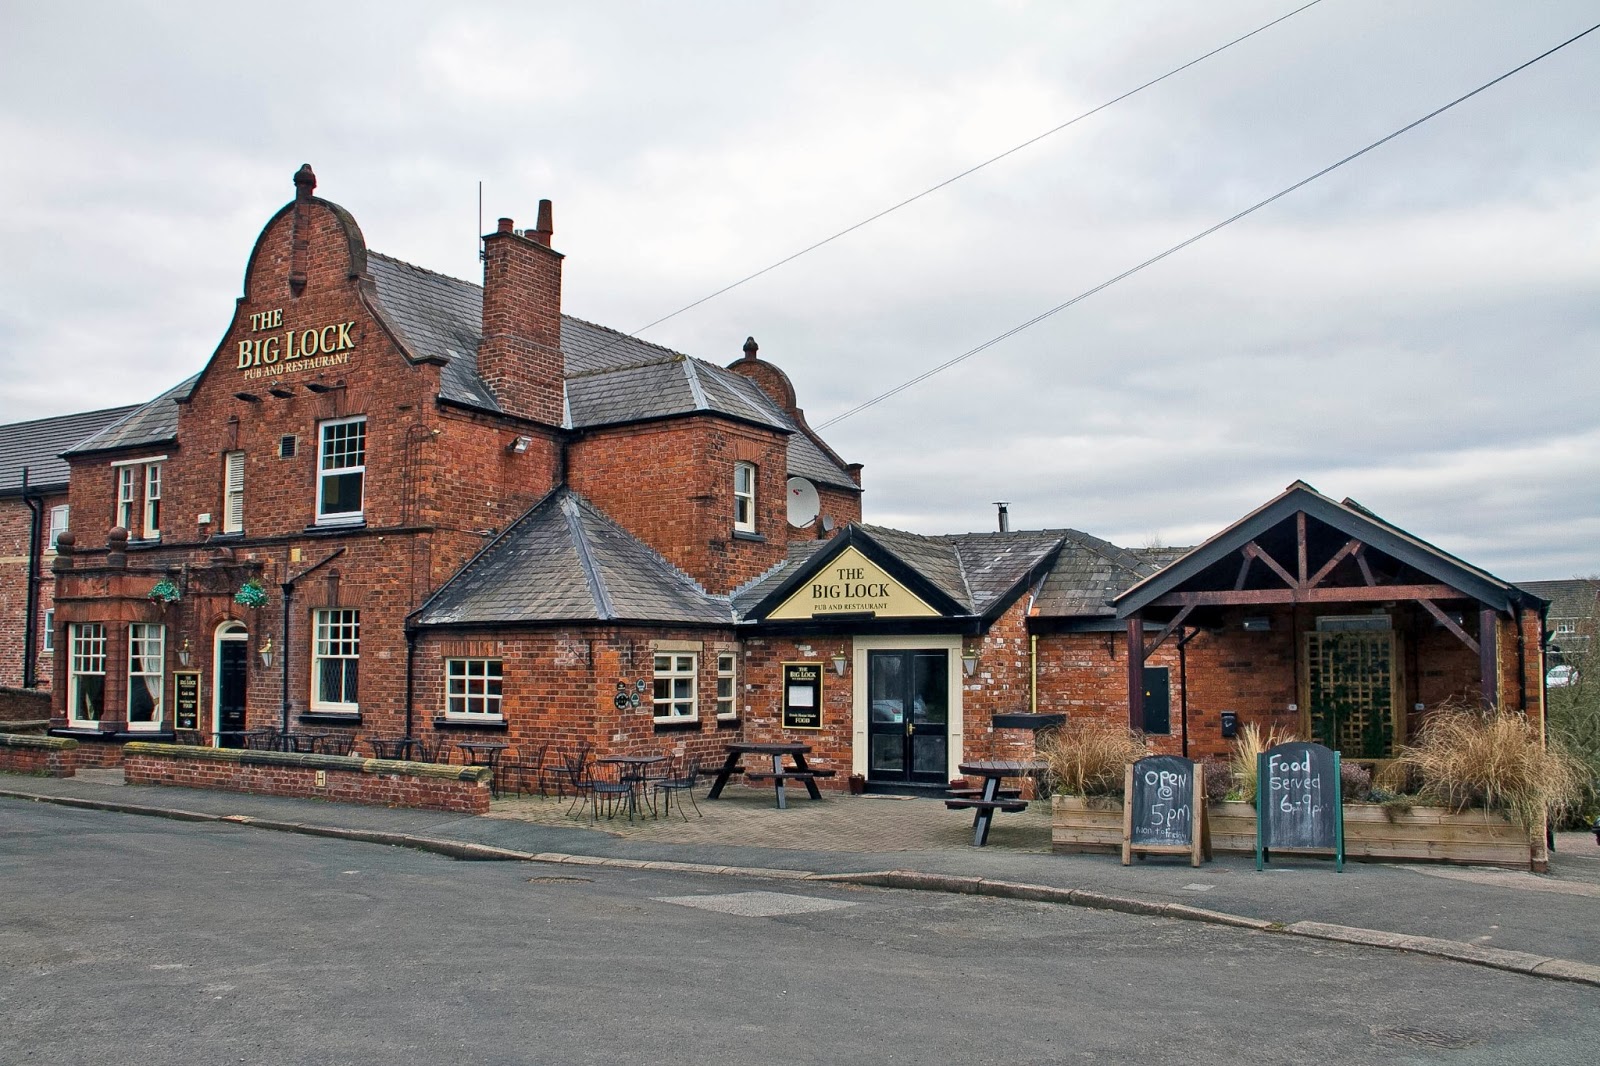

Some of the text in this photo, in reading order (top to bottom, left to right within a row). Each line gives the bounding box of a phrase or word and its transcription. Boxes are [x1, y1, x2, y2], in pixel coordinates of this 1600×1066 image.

[249, 308, 283, 332] THE
[236, 321, 355, 369] BIG LOCK
[244, 352, 350, 380] PUB AND RESTAURANT
[836, 568, 865, 580] THE
[812, 583, 890, 599] BIG LOCK
[1269, 750, 1311, 773] Food
[1269, 773, 1321, 790] Served
[1157, 785, 1174, 801] @
